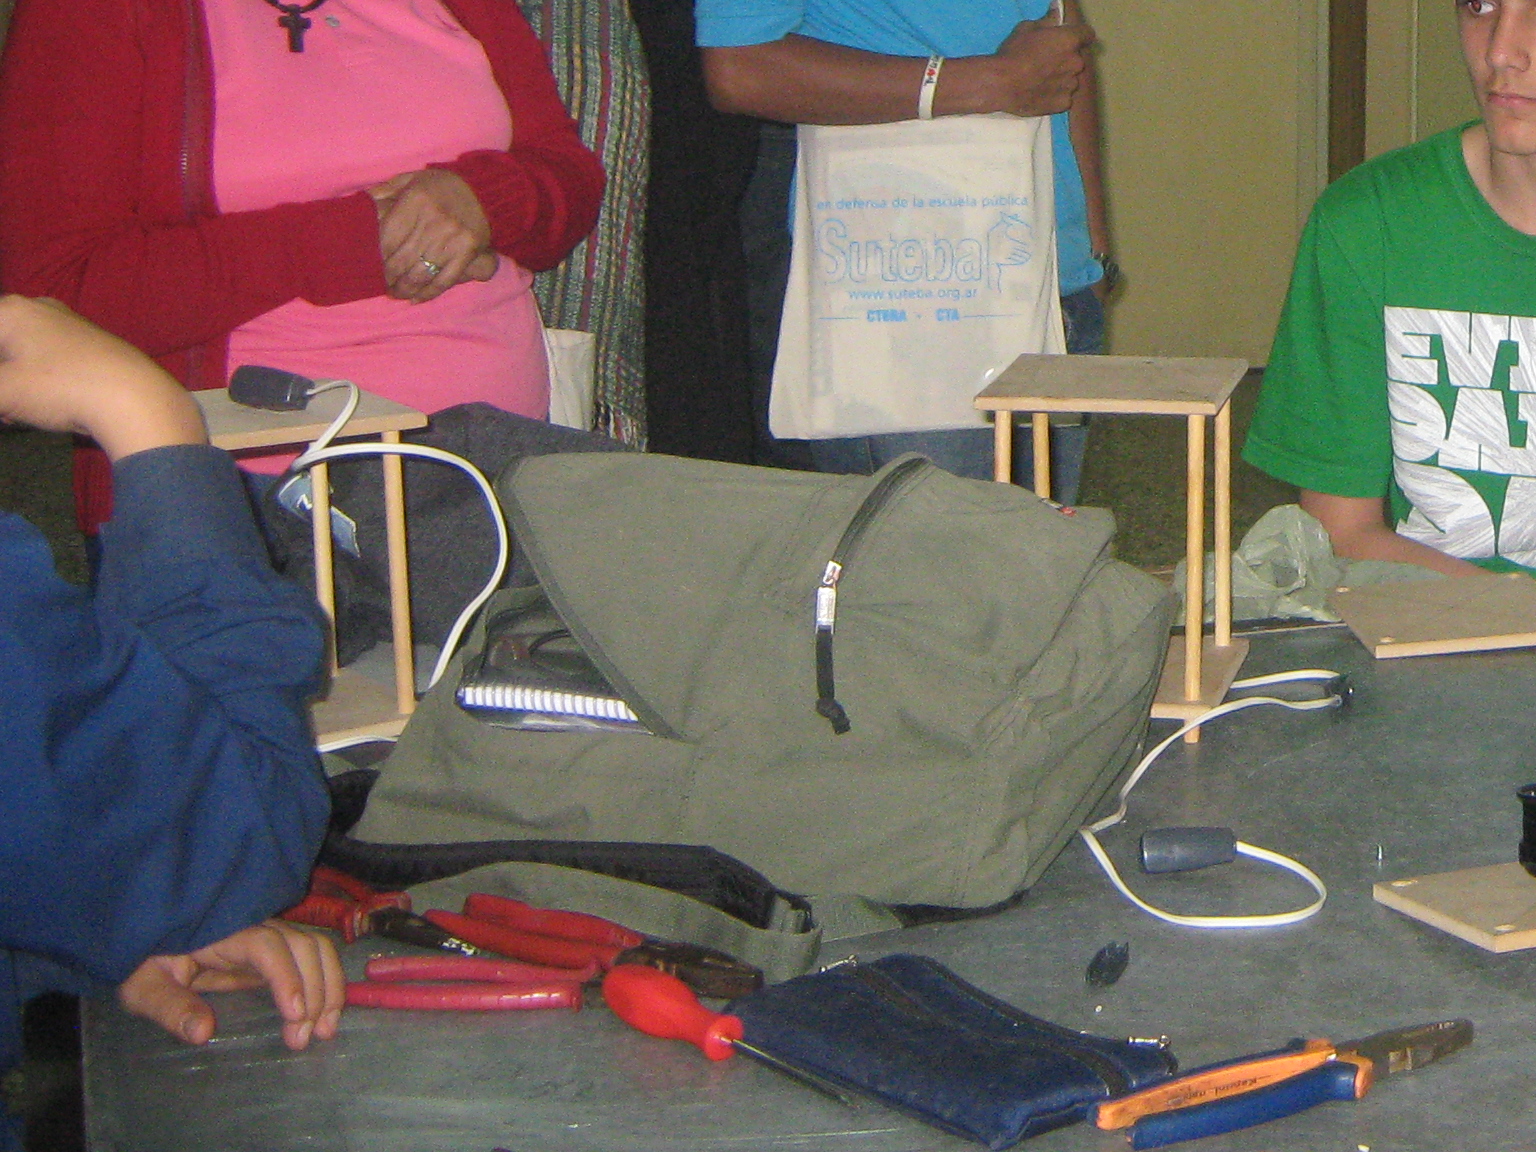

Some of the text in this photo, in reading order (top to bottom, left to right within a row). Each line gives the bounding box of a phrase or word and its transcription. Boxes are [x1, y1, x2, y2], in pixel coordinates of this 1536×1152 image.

[836, 196, 888, 209] defensa
[892, 195, 909, 208] de
[913, 194, 925, 207] la
[929, 194, 977, 208] escuela
[815, 217, 983, 284] Suteba
